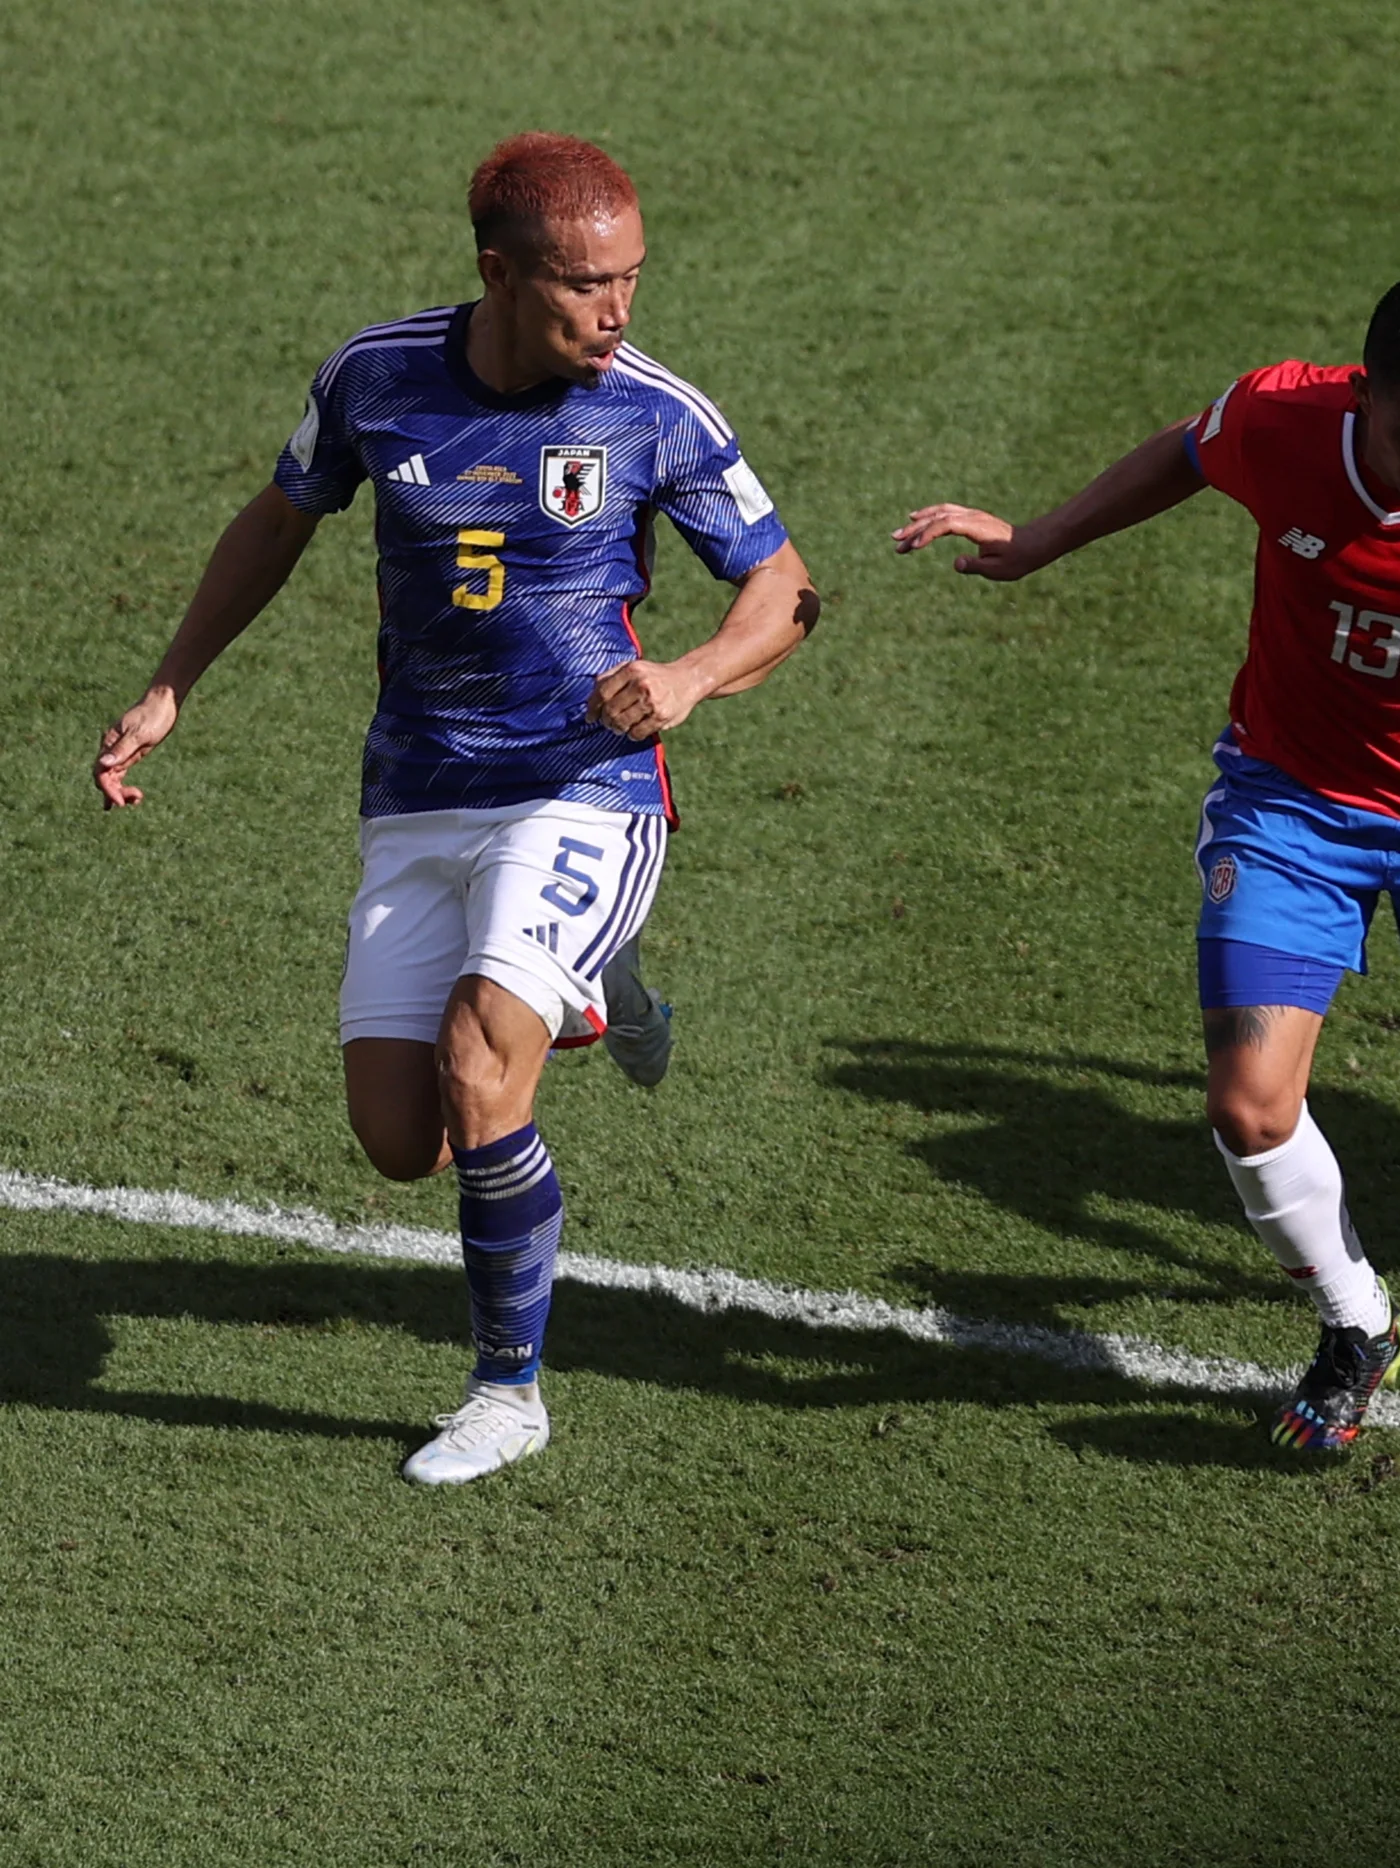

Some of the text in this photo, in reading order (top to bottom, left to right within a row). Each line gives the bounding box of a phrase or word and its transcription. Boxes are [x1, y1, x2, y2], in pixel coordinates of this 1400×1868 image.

[557, 448, 591, 456] JAPAN
[452, 530, 505, 611] 5
[540, 836, 604, 917] 5
[471, 1333, 533, 1359] PAN
